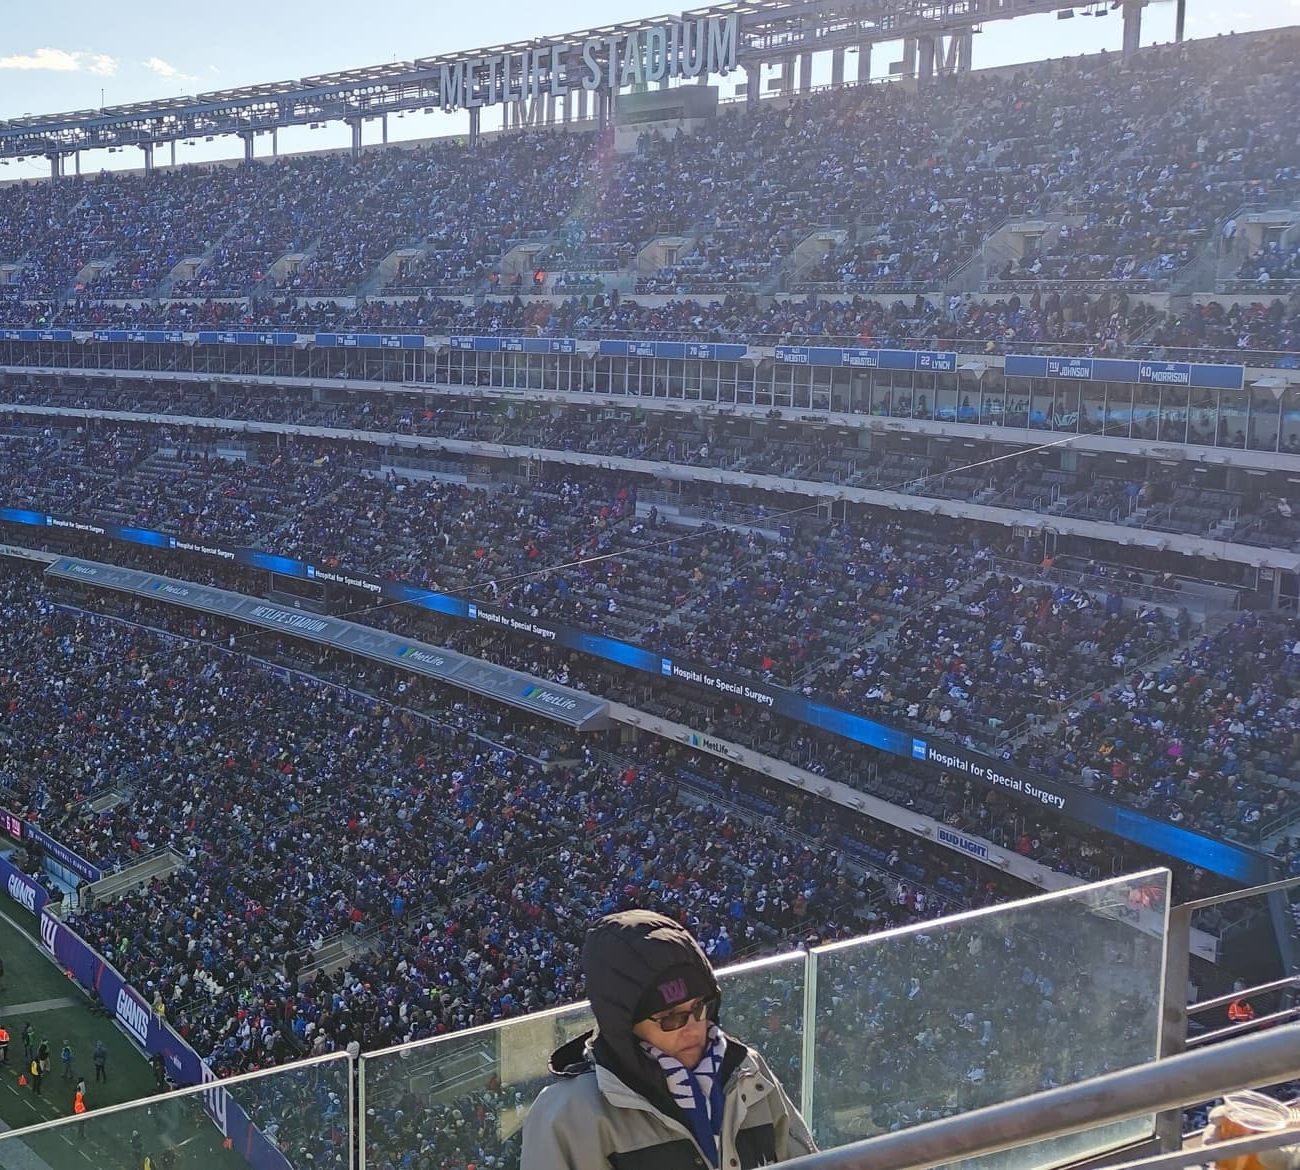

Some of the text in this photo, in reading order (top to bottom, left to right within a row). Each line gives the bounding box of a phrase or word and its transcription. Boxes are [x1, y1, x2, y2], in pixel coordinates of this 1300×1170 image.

[439, 44, 571, 110] METLIFE
[581, 13, 740, 94] STADIUM
[921, 356, 951, 370] 22 LYNCH
[1060, 367, 1090, 377] JOHNSON
[1141, 366, 1189, 383] 40 MORRISON
[217, 549, 235, 560] Surgery
[163, 584, 189, 596] MetLife
[315, 570, 382, 593] Hospital for Special Surgery
[250, 605, 328, 632] METLIFE STADIUM
[477, 609, 556, 640] Hospital for Special Surgery
[409, 650, 445, 666] MetLife
[673, 665, 774, 706] Hospital for Special Surgery
[536, 691, 577, 710] MetLife
[703, 738, 729, 754] MetLife
[929, 748, 1065, 809] Hospital for Special Surgery
[939, 829, 987, 857] BUD LIGHT
[8, 874, 36, 914] GIANTS
[40, 912, 58, 956] ny
[658, 978, 688, 1004] ny
[116, 988, 149, 1044] GIANTS
